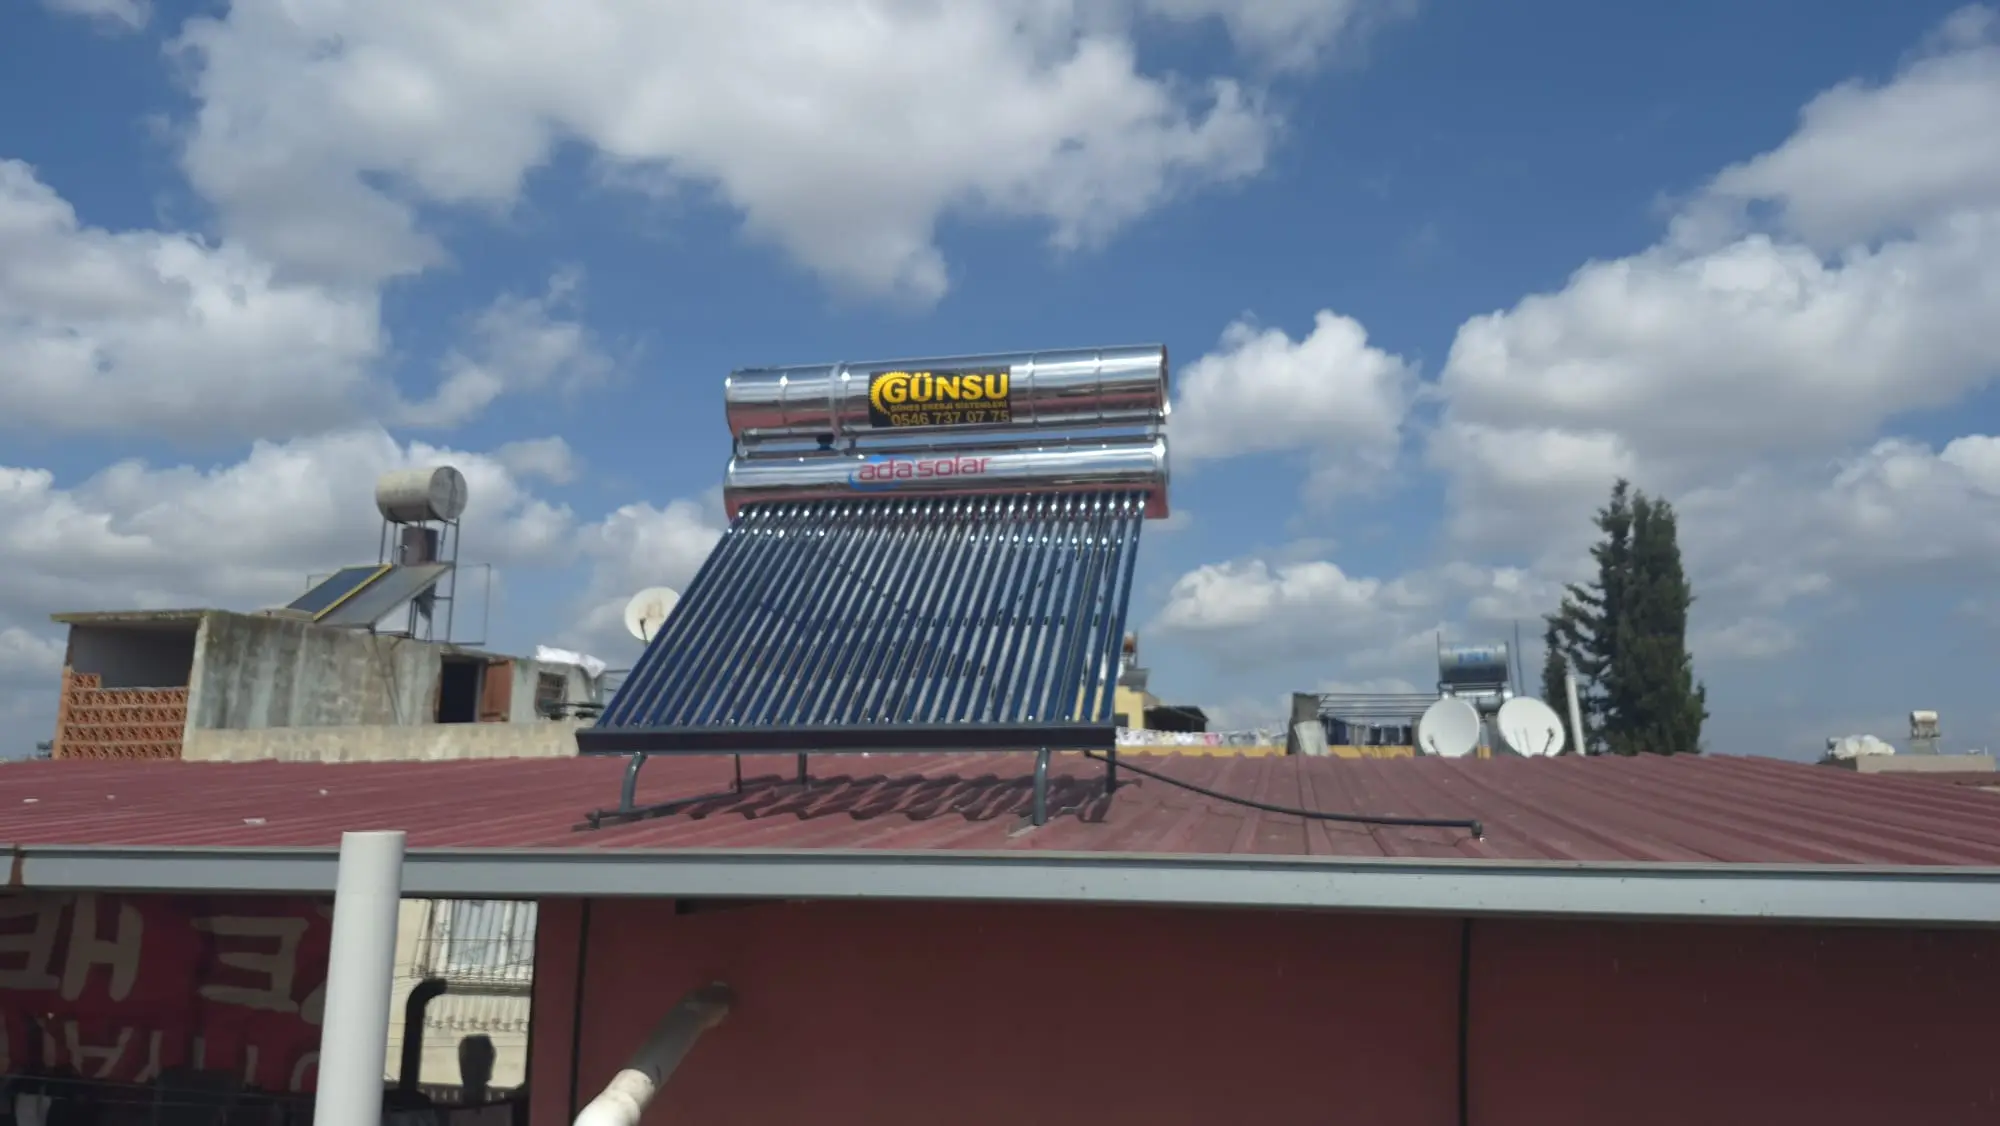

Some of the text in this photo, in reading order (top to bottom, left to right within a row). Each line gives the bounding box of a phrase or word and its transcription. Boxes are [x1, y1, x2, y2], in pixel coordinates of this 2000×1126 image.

[882, 372, 1009, 404] GÜNSU
[891, 410, 1010, 426] 0546 737 07 75
